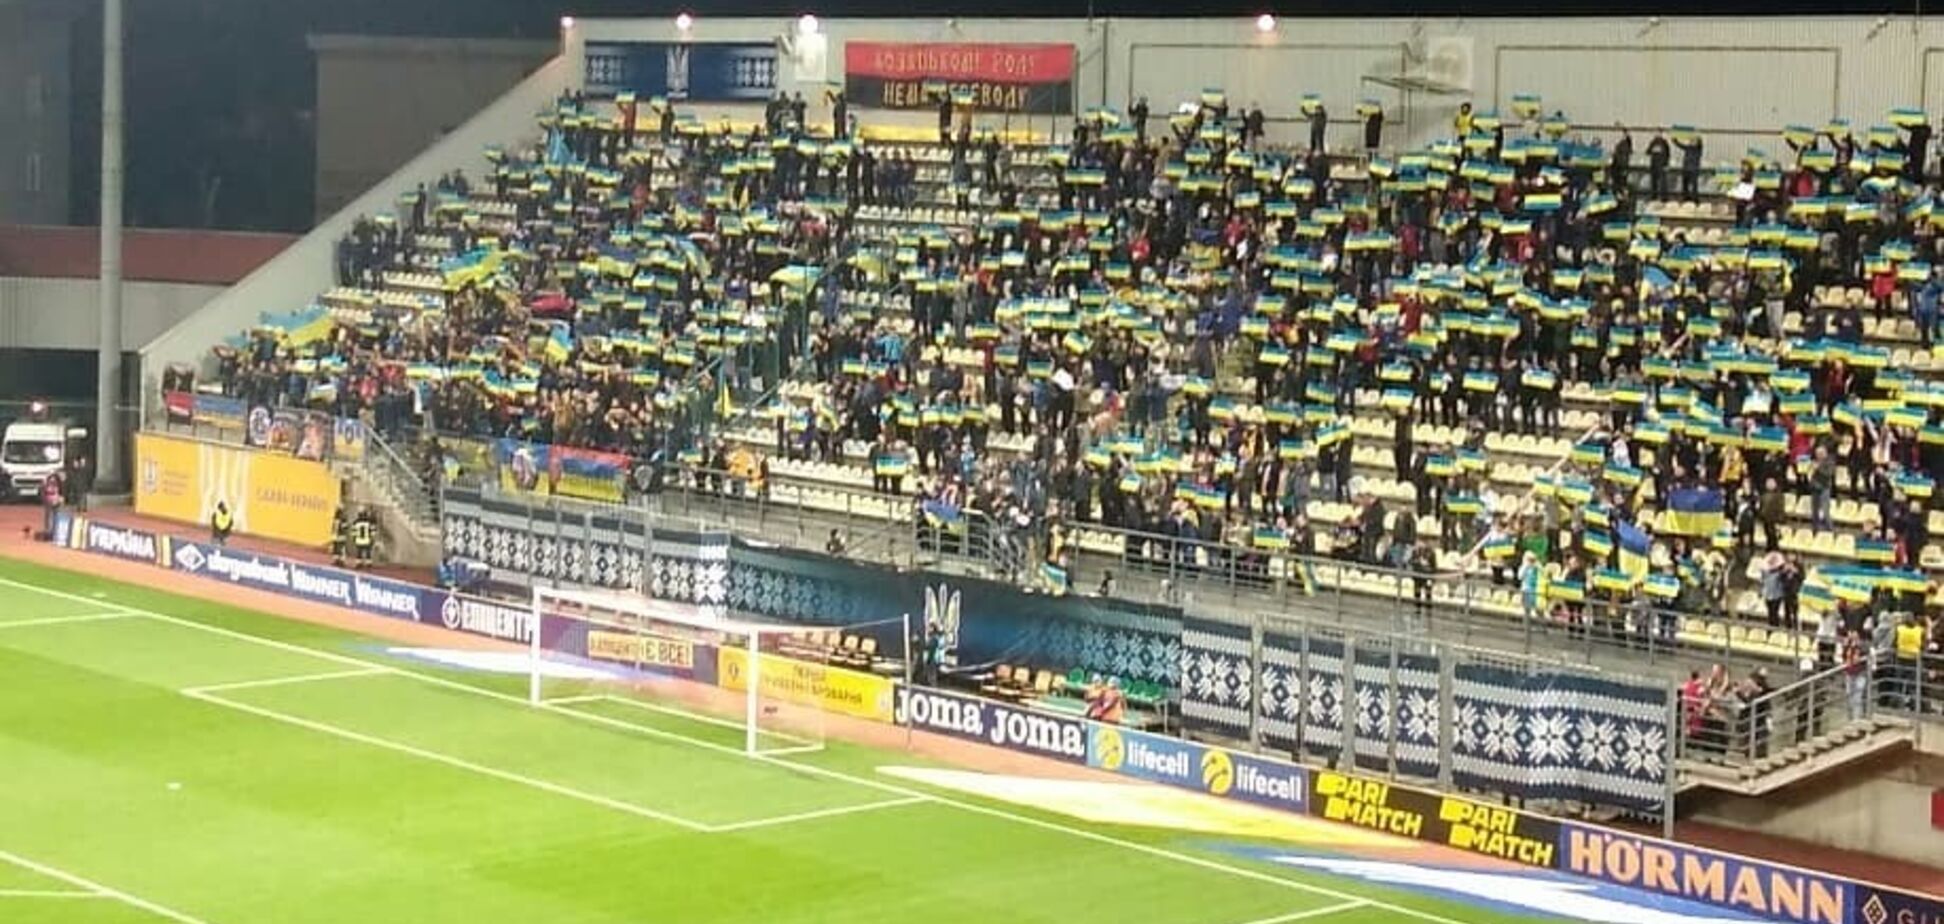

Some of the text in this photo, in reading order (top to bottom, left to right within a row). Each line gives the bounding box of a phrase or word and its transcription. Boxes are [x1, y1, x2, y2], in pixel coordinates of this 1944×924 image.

[1127, 741, 1190, 778] lifecell
[1236, 763, 1302, 801] lifecell
[1334, 775, 1389, 806] PARI
[1346, 799, 1423, 837] MATCH
[1459, 801, 1517, 834] PARI
[1472, 826, 1554, 867] MATCH
[1569, 829, 1844, 924] HÖRMANN
